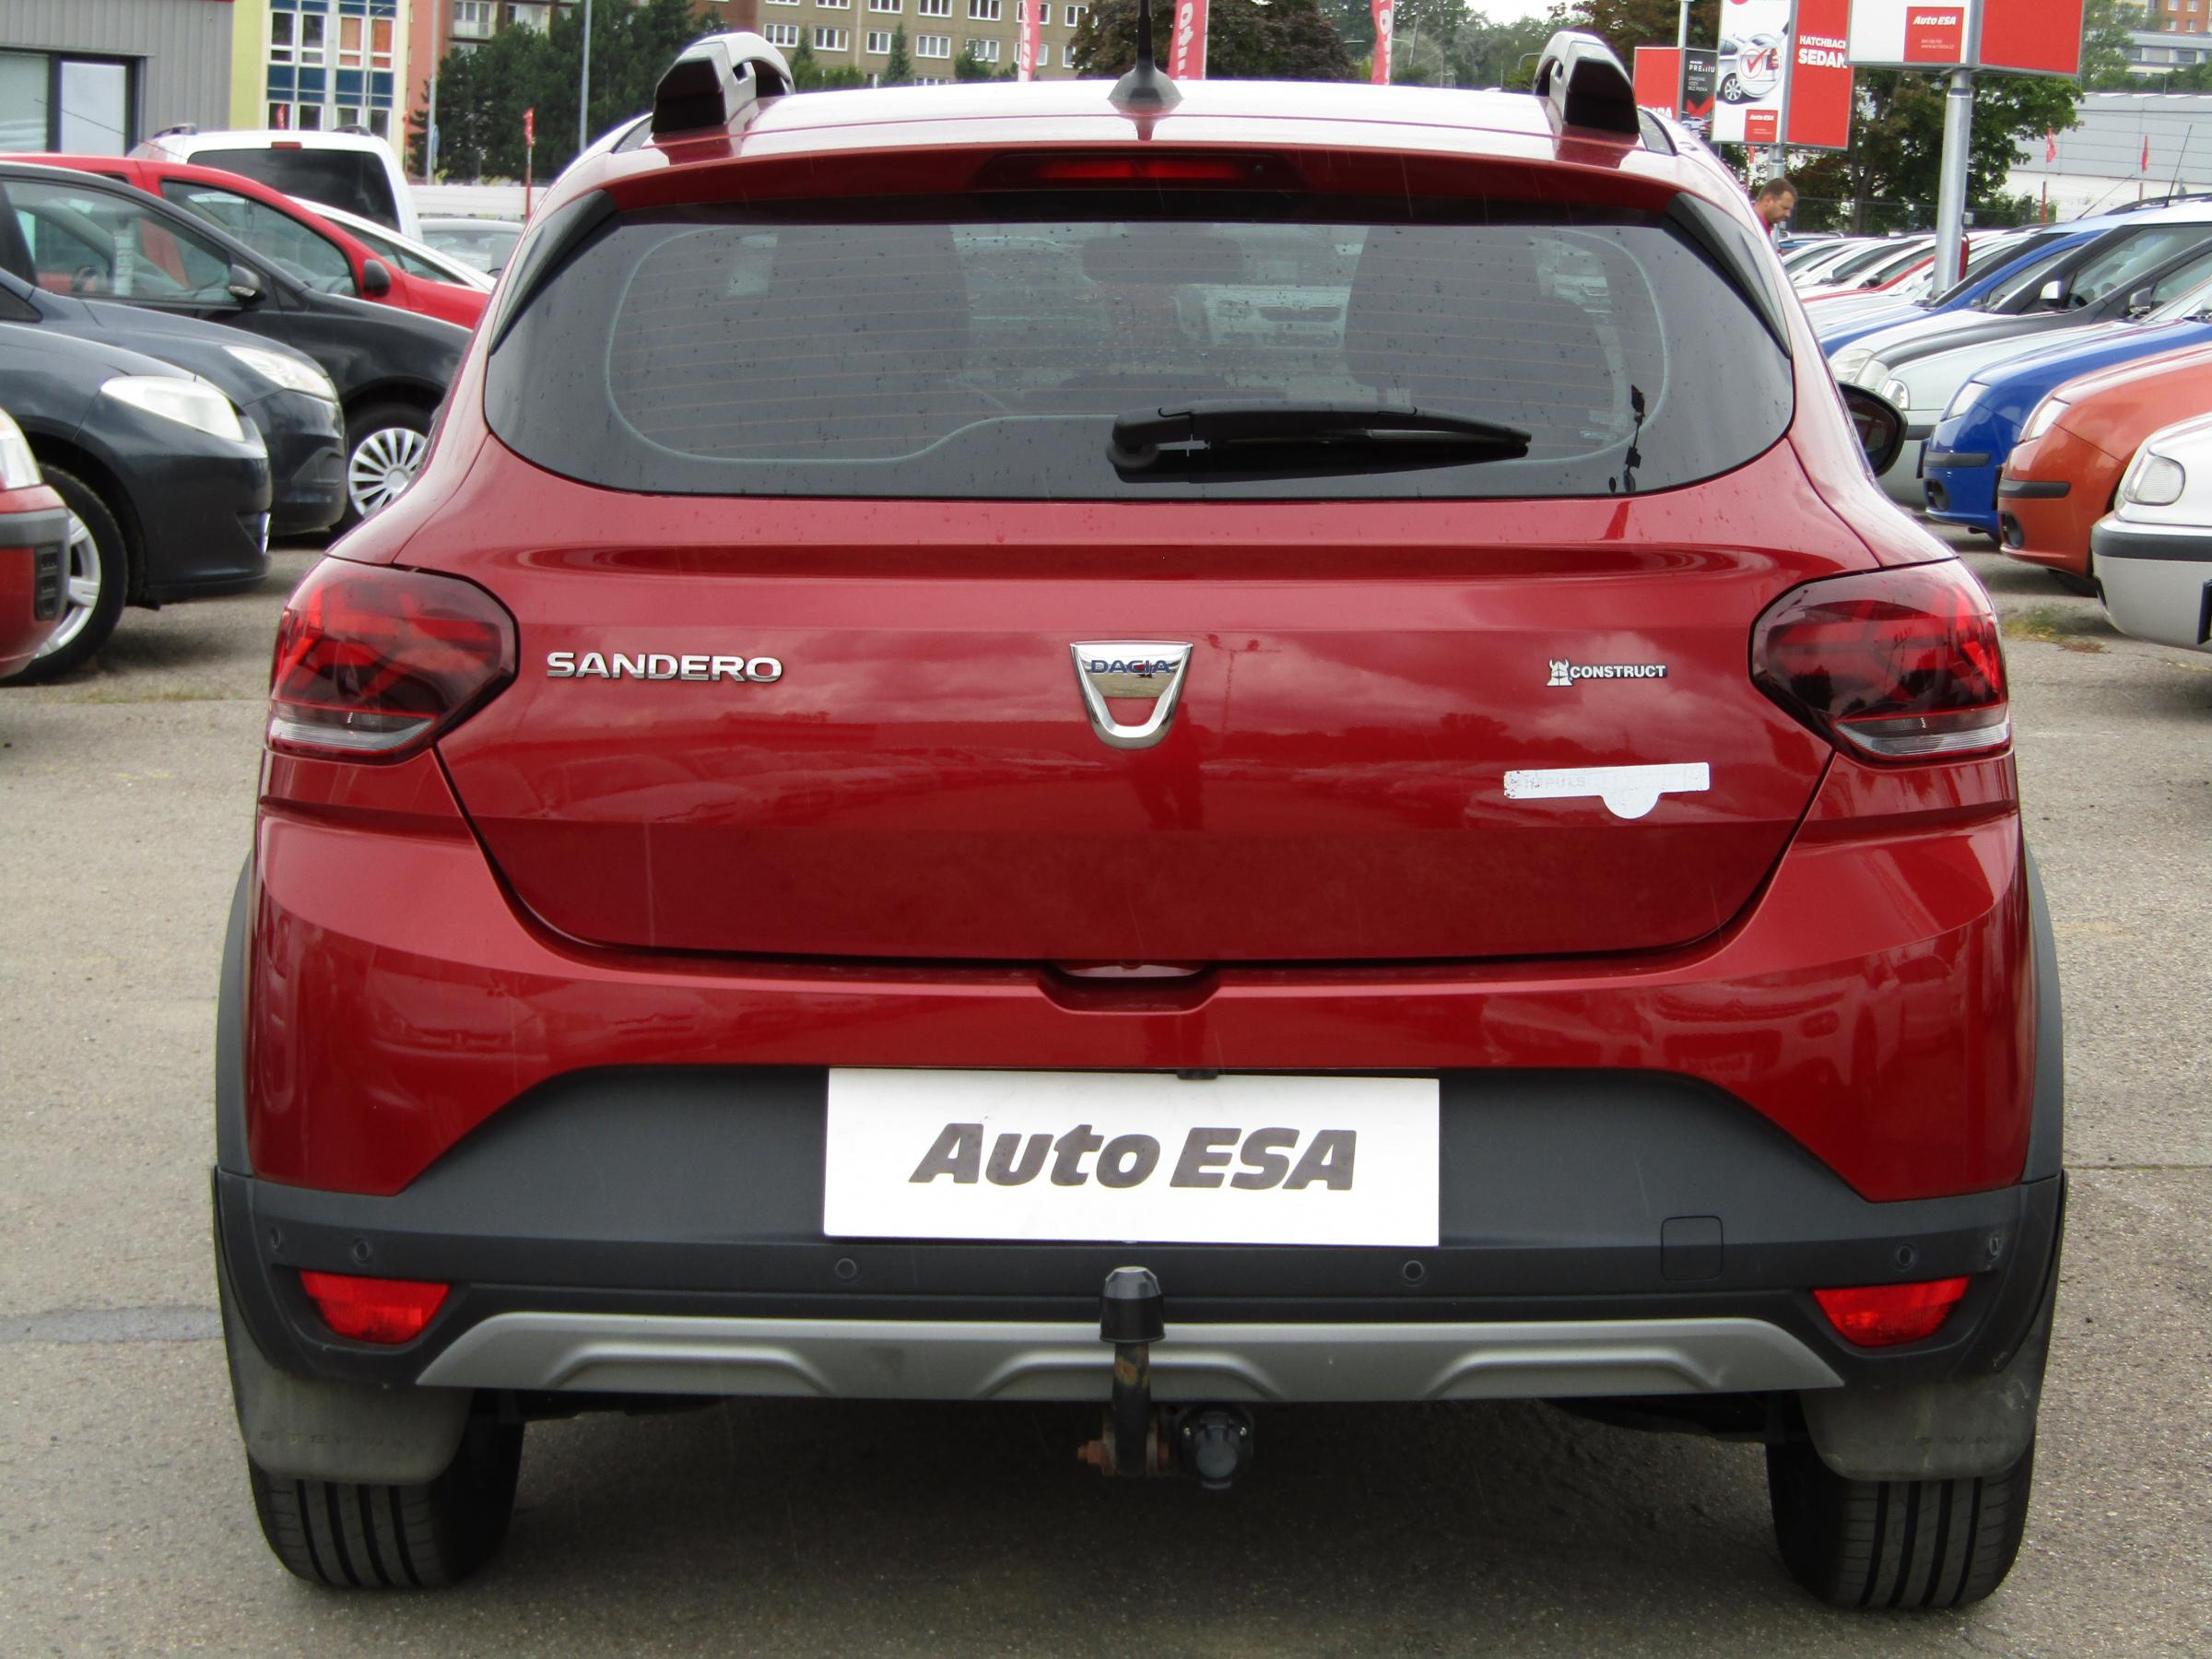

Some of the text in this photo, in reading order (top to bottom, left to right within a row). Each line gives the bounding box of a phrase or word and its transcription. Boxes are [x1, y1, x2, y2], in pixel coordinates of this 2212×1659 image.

[1912, 16, 1957, 26] Auto ESA
[547, 652, 783, 683] SANDERO
[1090, 659, 1171, 675] DACIA
[1569, 665, 1666, 679] CONSTRUCT
[908, 1123, 1358, 1191] Auto ESA
